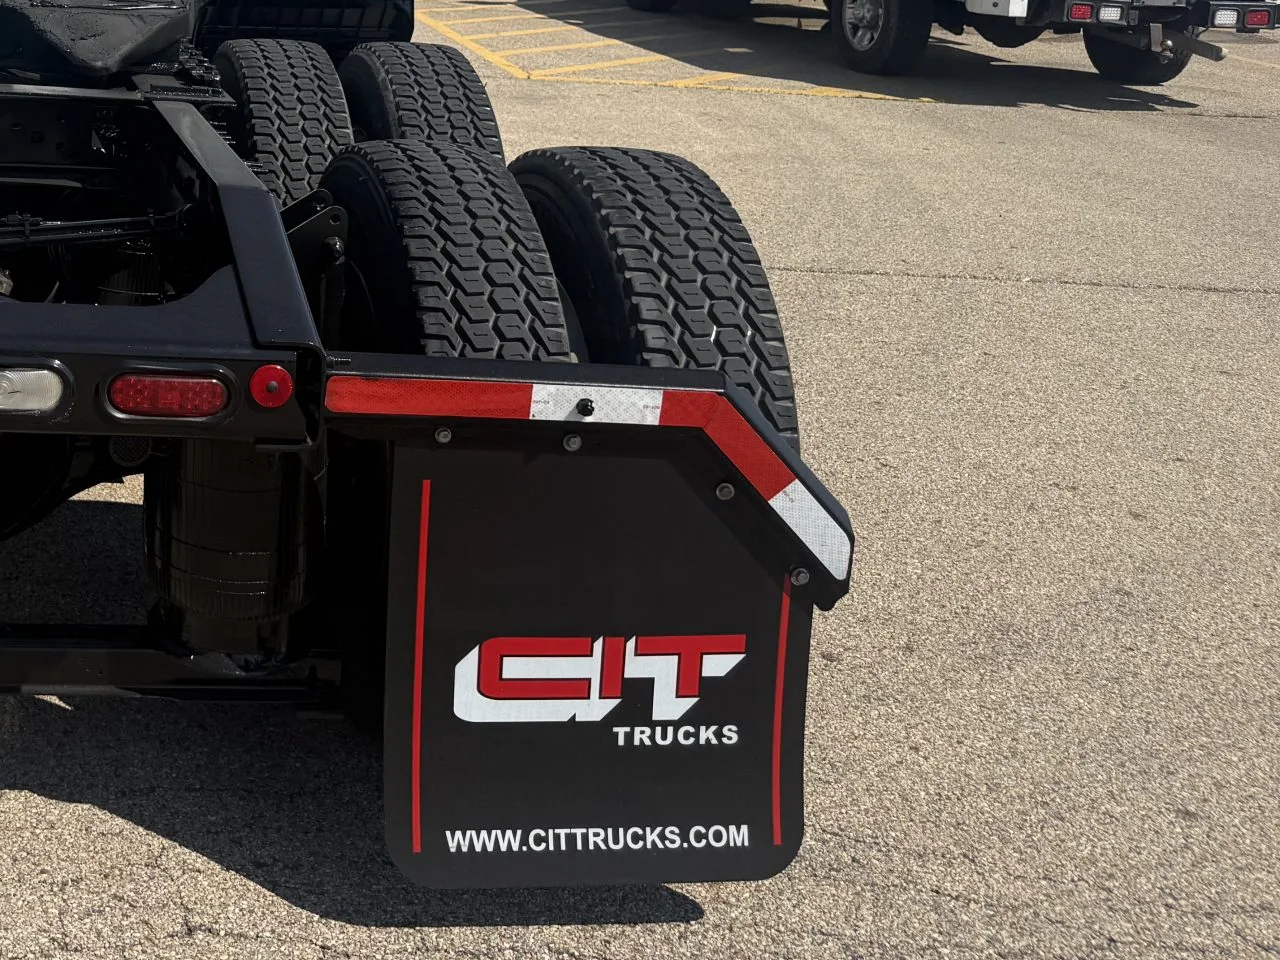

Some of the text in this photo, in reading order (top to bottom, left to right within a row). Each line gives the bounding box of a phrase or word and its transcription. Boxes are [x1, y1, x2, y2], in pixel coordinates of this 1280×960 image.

[454, 634, 746, 722] CIT
[613, 725, 739, 746] TRUCKS
[445, 824, 749, 852] WWW.CITTRUCKS.COM
